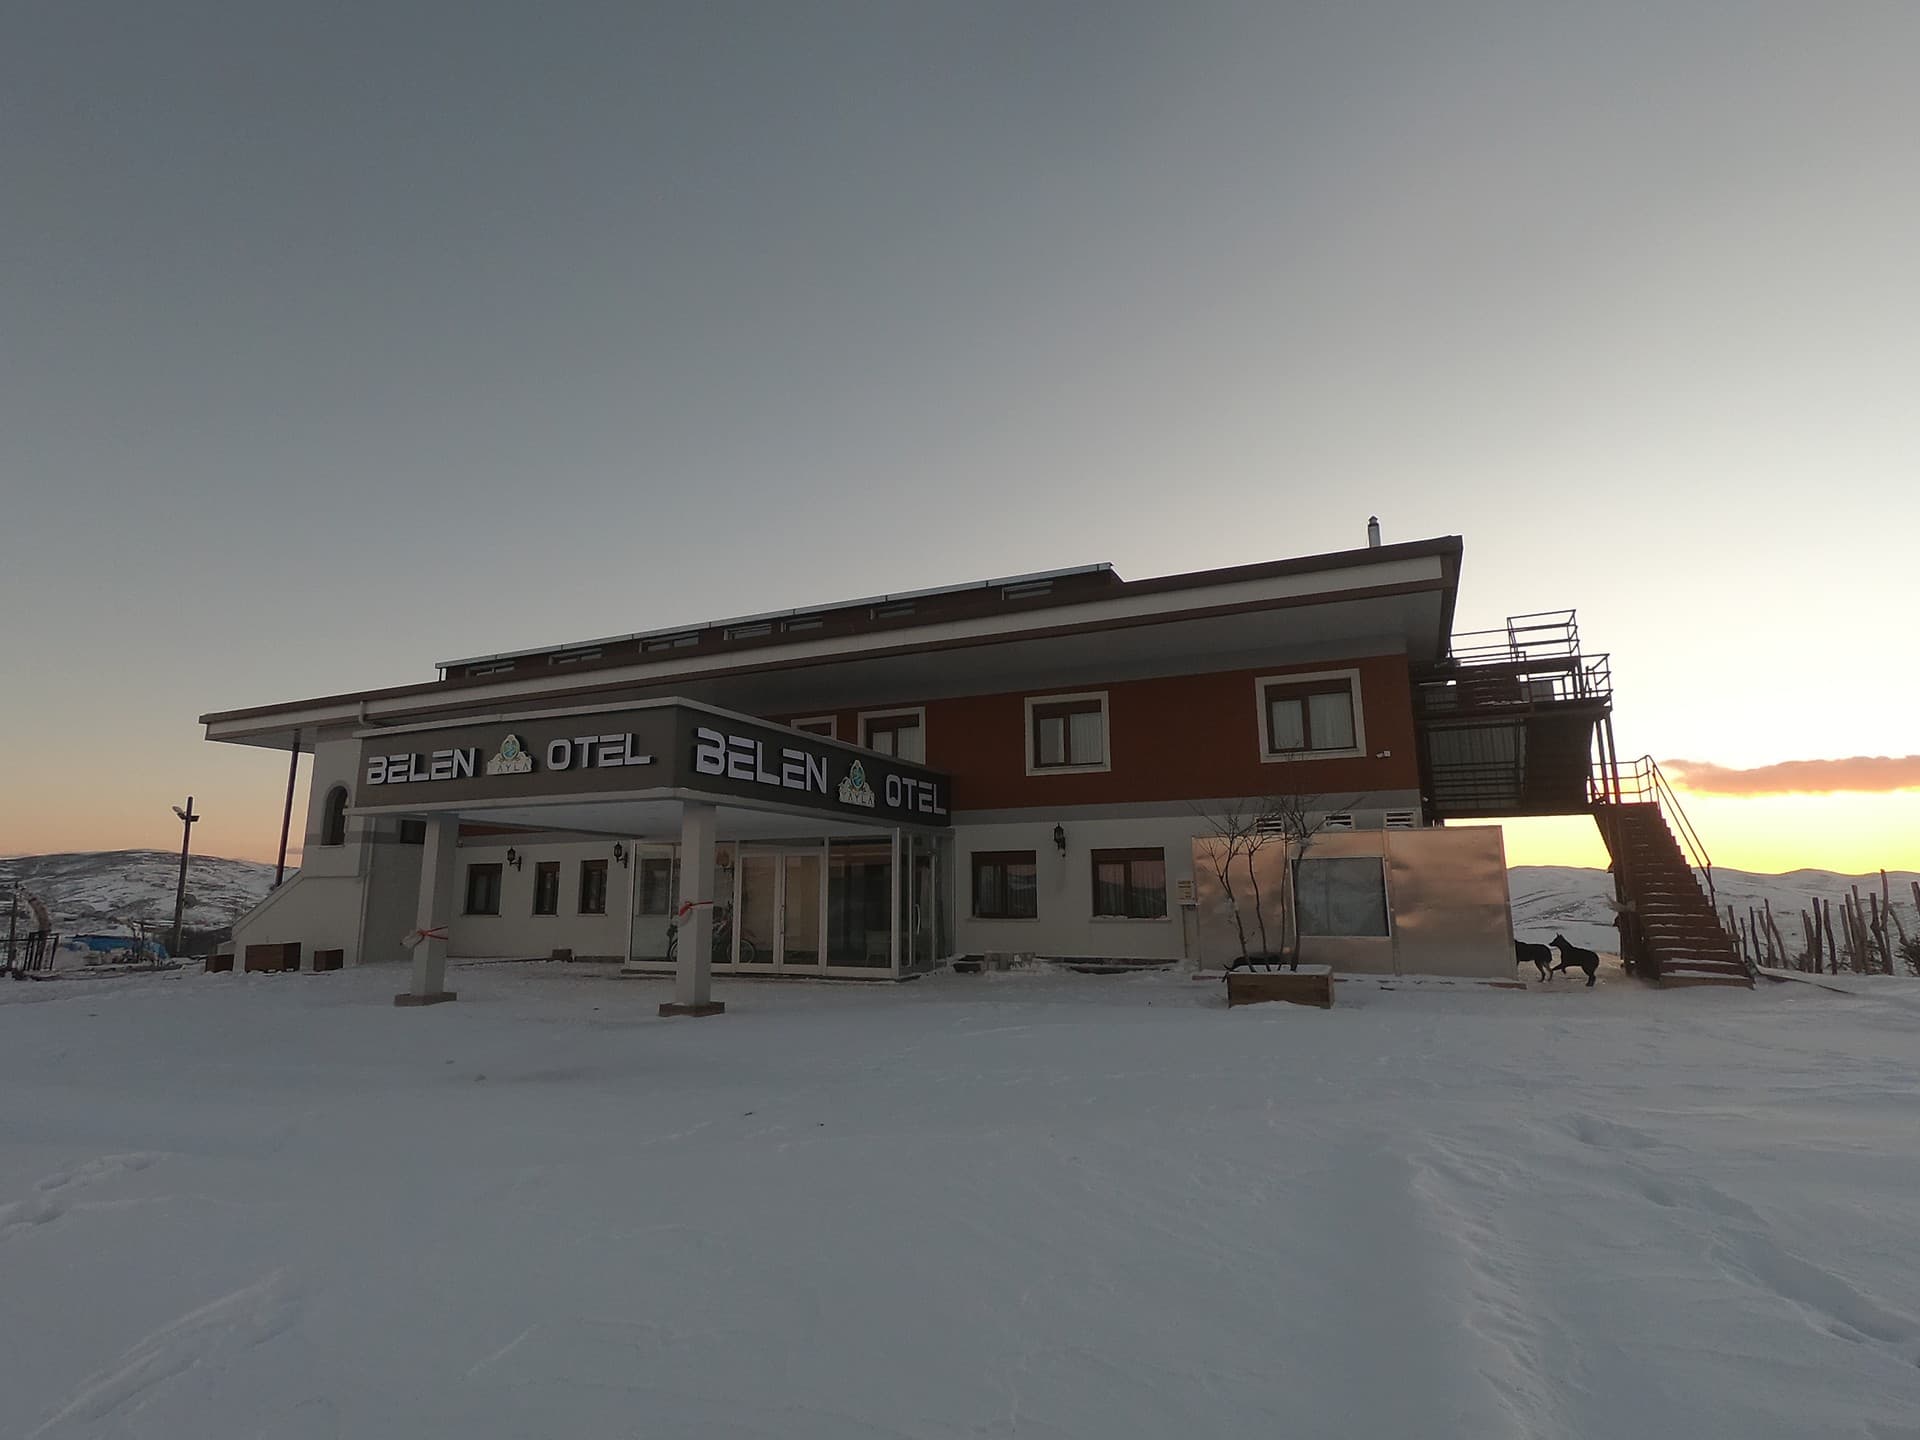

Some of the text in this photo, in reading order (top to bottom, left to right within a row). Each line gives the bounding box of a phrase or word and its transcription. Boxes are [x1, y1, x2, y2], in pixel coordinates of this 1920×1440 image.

[366, 732, 652, 785] BELEN OTEL
[696, 727, 947, 815] BELEN OTEL
